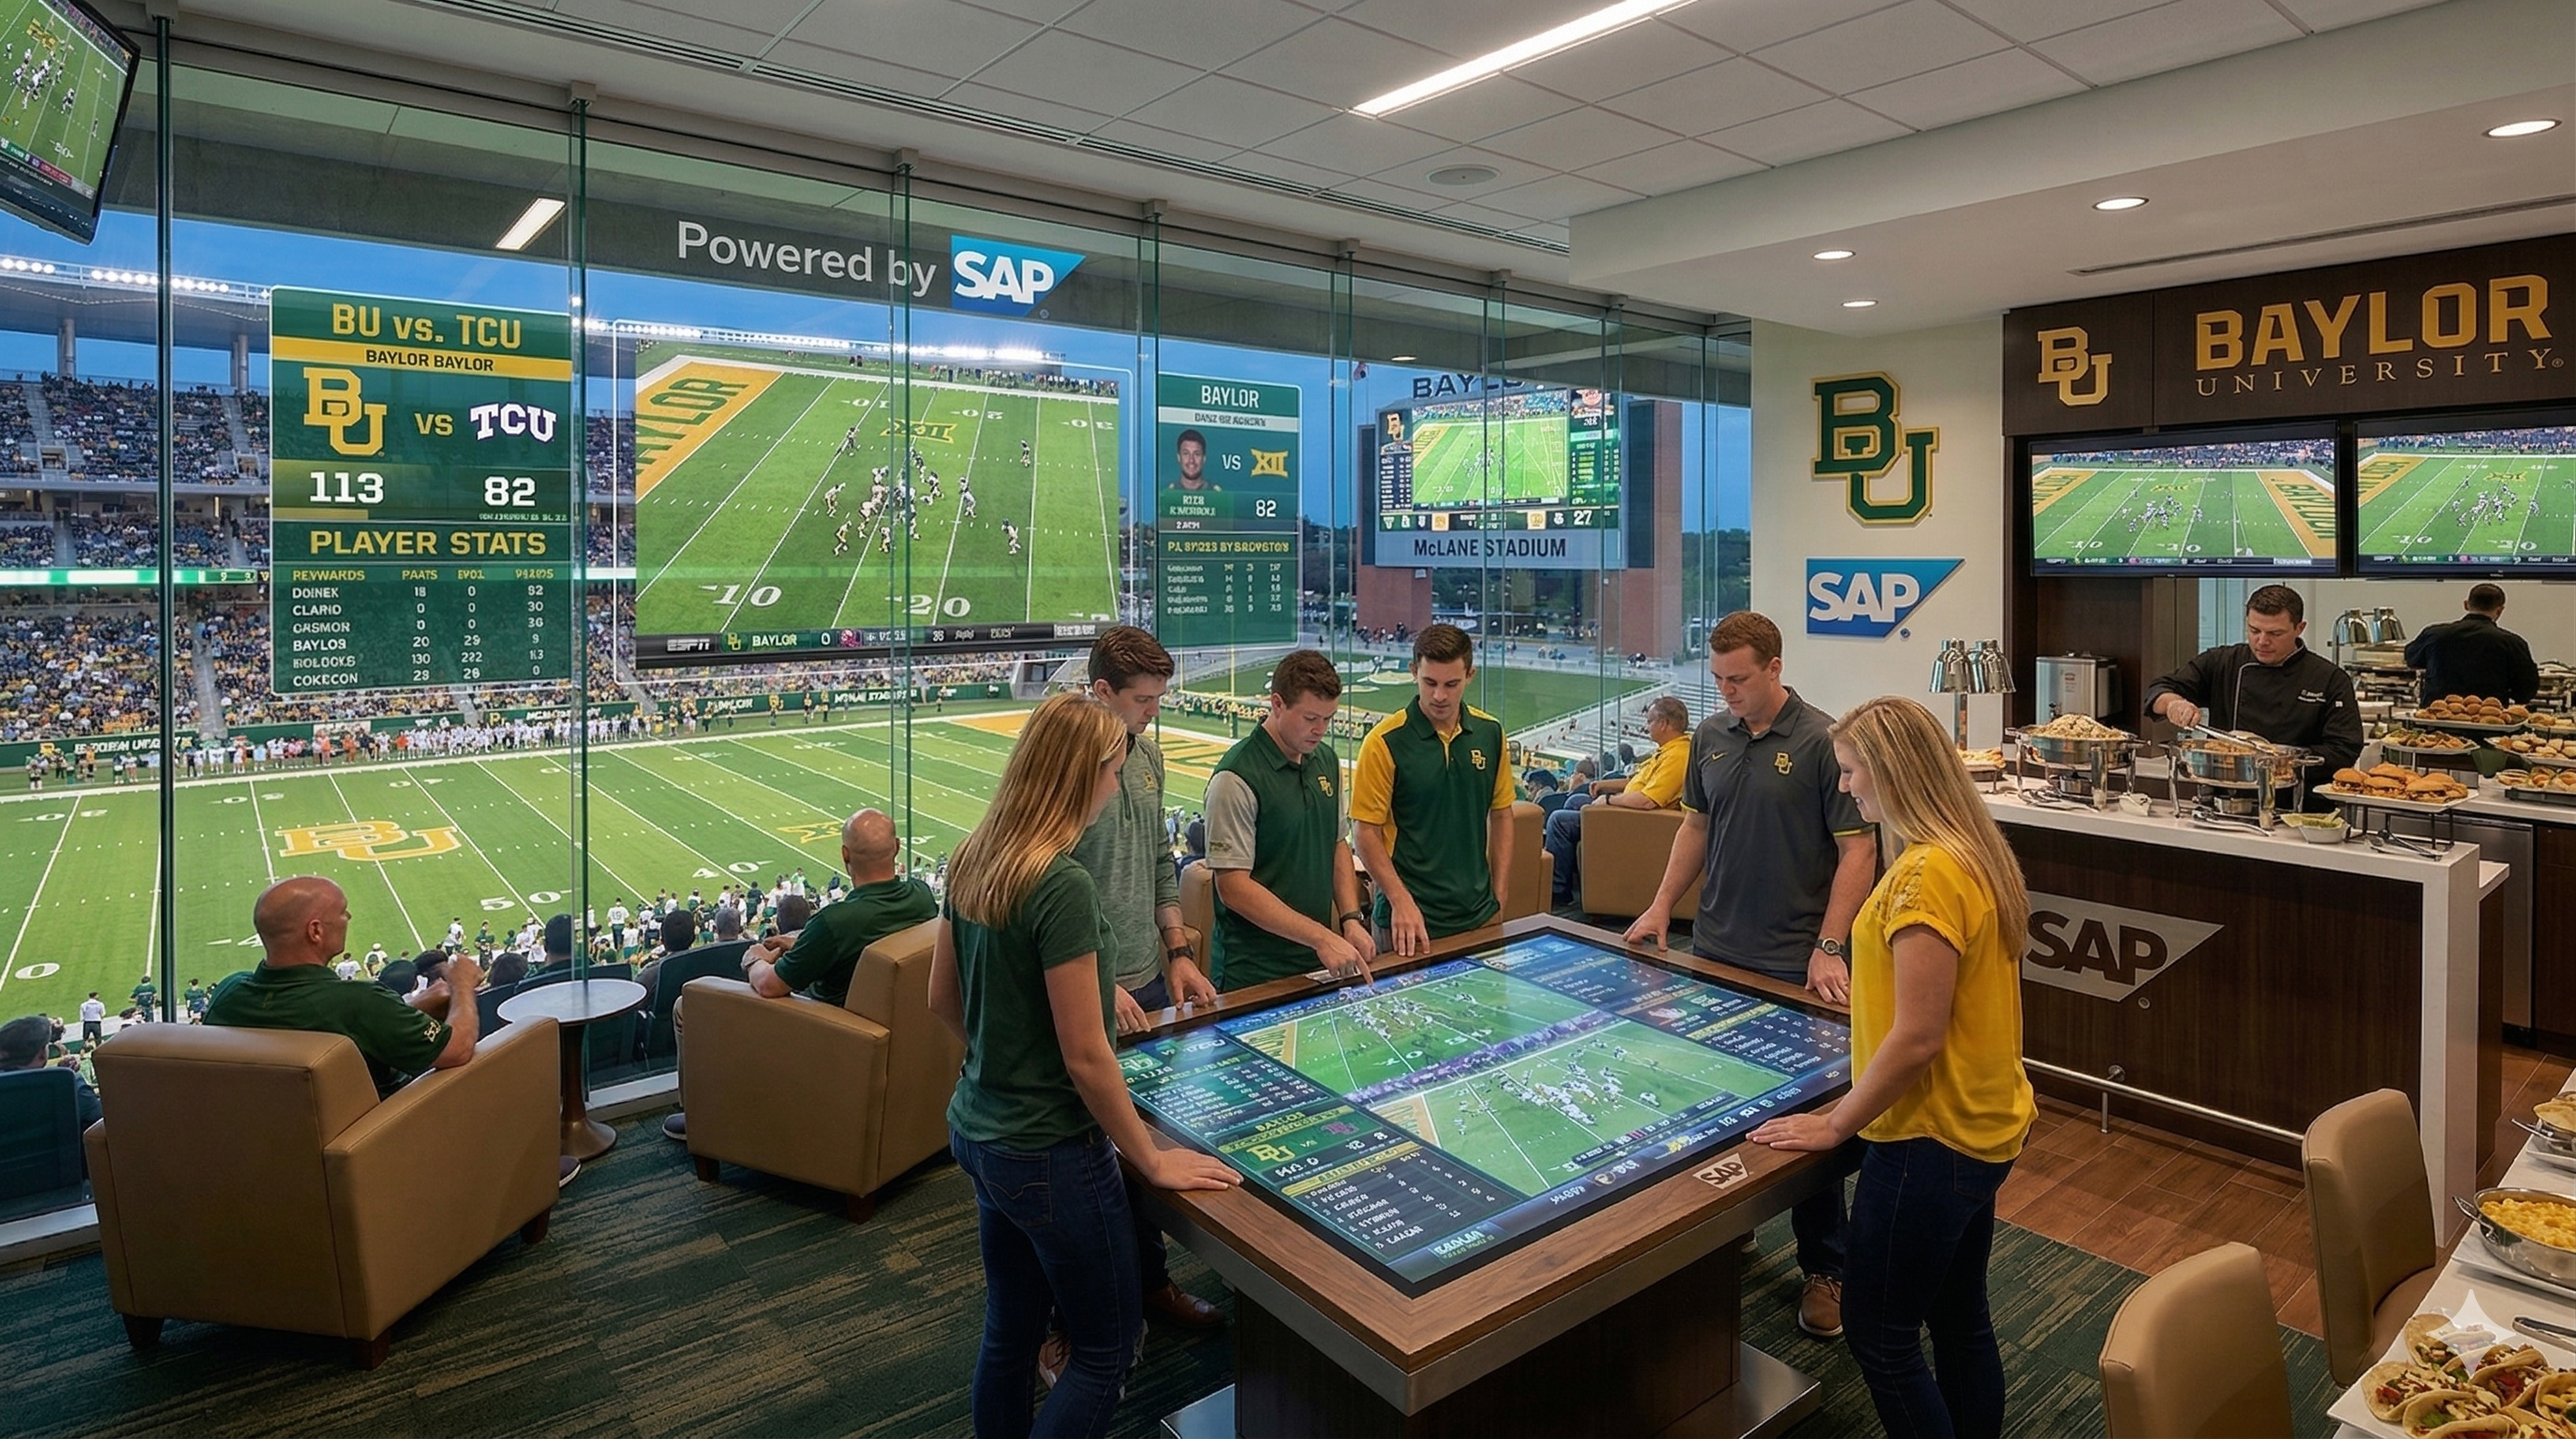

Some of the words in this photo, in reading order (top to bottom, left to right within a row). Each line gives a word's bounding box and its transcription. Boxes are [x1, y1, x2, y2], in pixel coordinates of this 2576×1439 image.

[678, 220, 872, 282] Powered
[888, 249, 937, 297] by
[954, 250, 1055, 304] SAP
[333, 303, 380, 337] BU
[456, 314, 521, 349] TCU
[2196, 274, 2553, 371] BAYLOR
[366, 349, 429, 367] BAYLOR
[434, 355, 494, 372] BAYLOR
[2038, 326, 2112, 406] BU
[2196, 348, 2552, 396] UNIVERSITY
[1202, 385, 1260, 408] BAYLOR
[303, 366, 387, 456] BU
[469, 403, 556, 444] TCU
[1812, 371, 1939, 525] BU
[309, 472, 384, 503] 113
[483, 476, 536, 507] 82
[1255, 499, 1277, 517] 82
[1573, 510, 1592, 526] 27
[310, 530, 438, 555] PLAYER
[451, 531, 547, 556] STATS
[1414, 539, 1479, 556] McLANE
[1486, 539, 1566, 556] STADIUM
[467, 586, 476, 597] 0
[1808, 571, 1920, 623] SAP
[416, 602, 425, 613] 0
[467, 602, 476, 613] 0
[527, 601, 543, 612] 30
[467, 618, 476, 629] 0
[412, 636, 430, 647] 20
[821, 631, 831, 645] 0
[532, 665, 540, 675] 0
[2025, 911, 2168, 986] SAP
[1700, 1161, 1743, 1185] SAP
